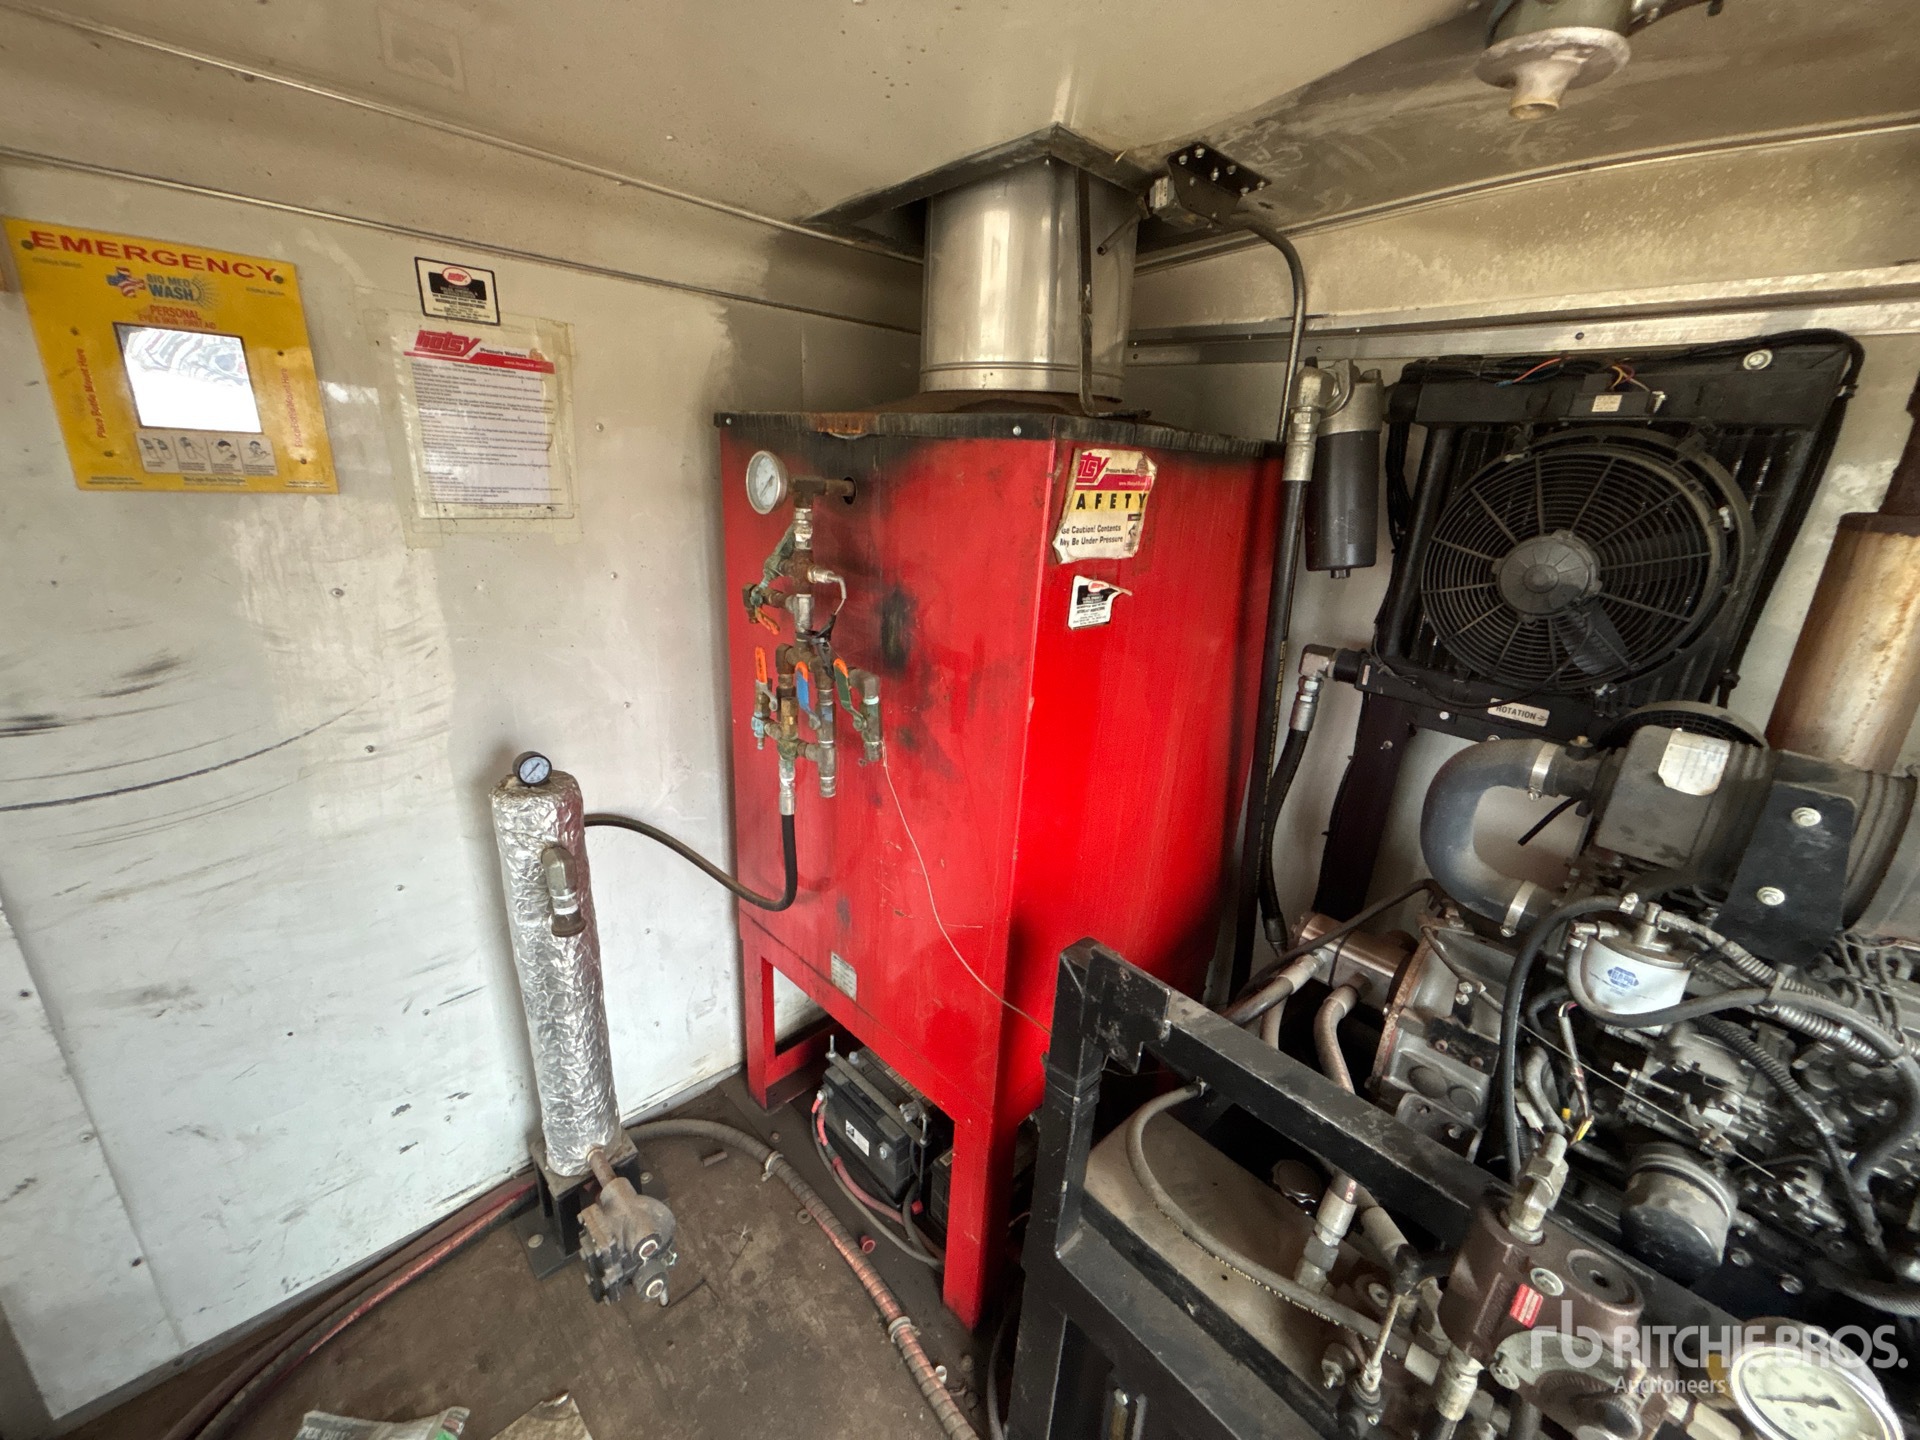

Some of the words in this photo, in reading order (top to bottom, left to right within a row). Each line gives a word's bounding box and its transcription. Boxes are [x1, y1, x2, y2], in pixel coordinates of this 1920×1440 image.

[30, 230, 276, 281] EMERGENCY
[148, 284, 194, 301] WASH
[150, 304, 201, 319] PERSONAL
[480, 347, 503, 356] Pressure
[504, 350, 526, 359] Washers
[1071, 525, 1096, 534] Caution!
[1097, 524, 1121, 532] Contents
[1071, 537, 1079, 546] Be
[1081, 536, 1098, 545] Under
[1099, 535, 1123, 544] Pressure
[1495, 706, 1537, 720] ROTATION
